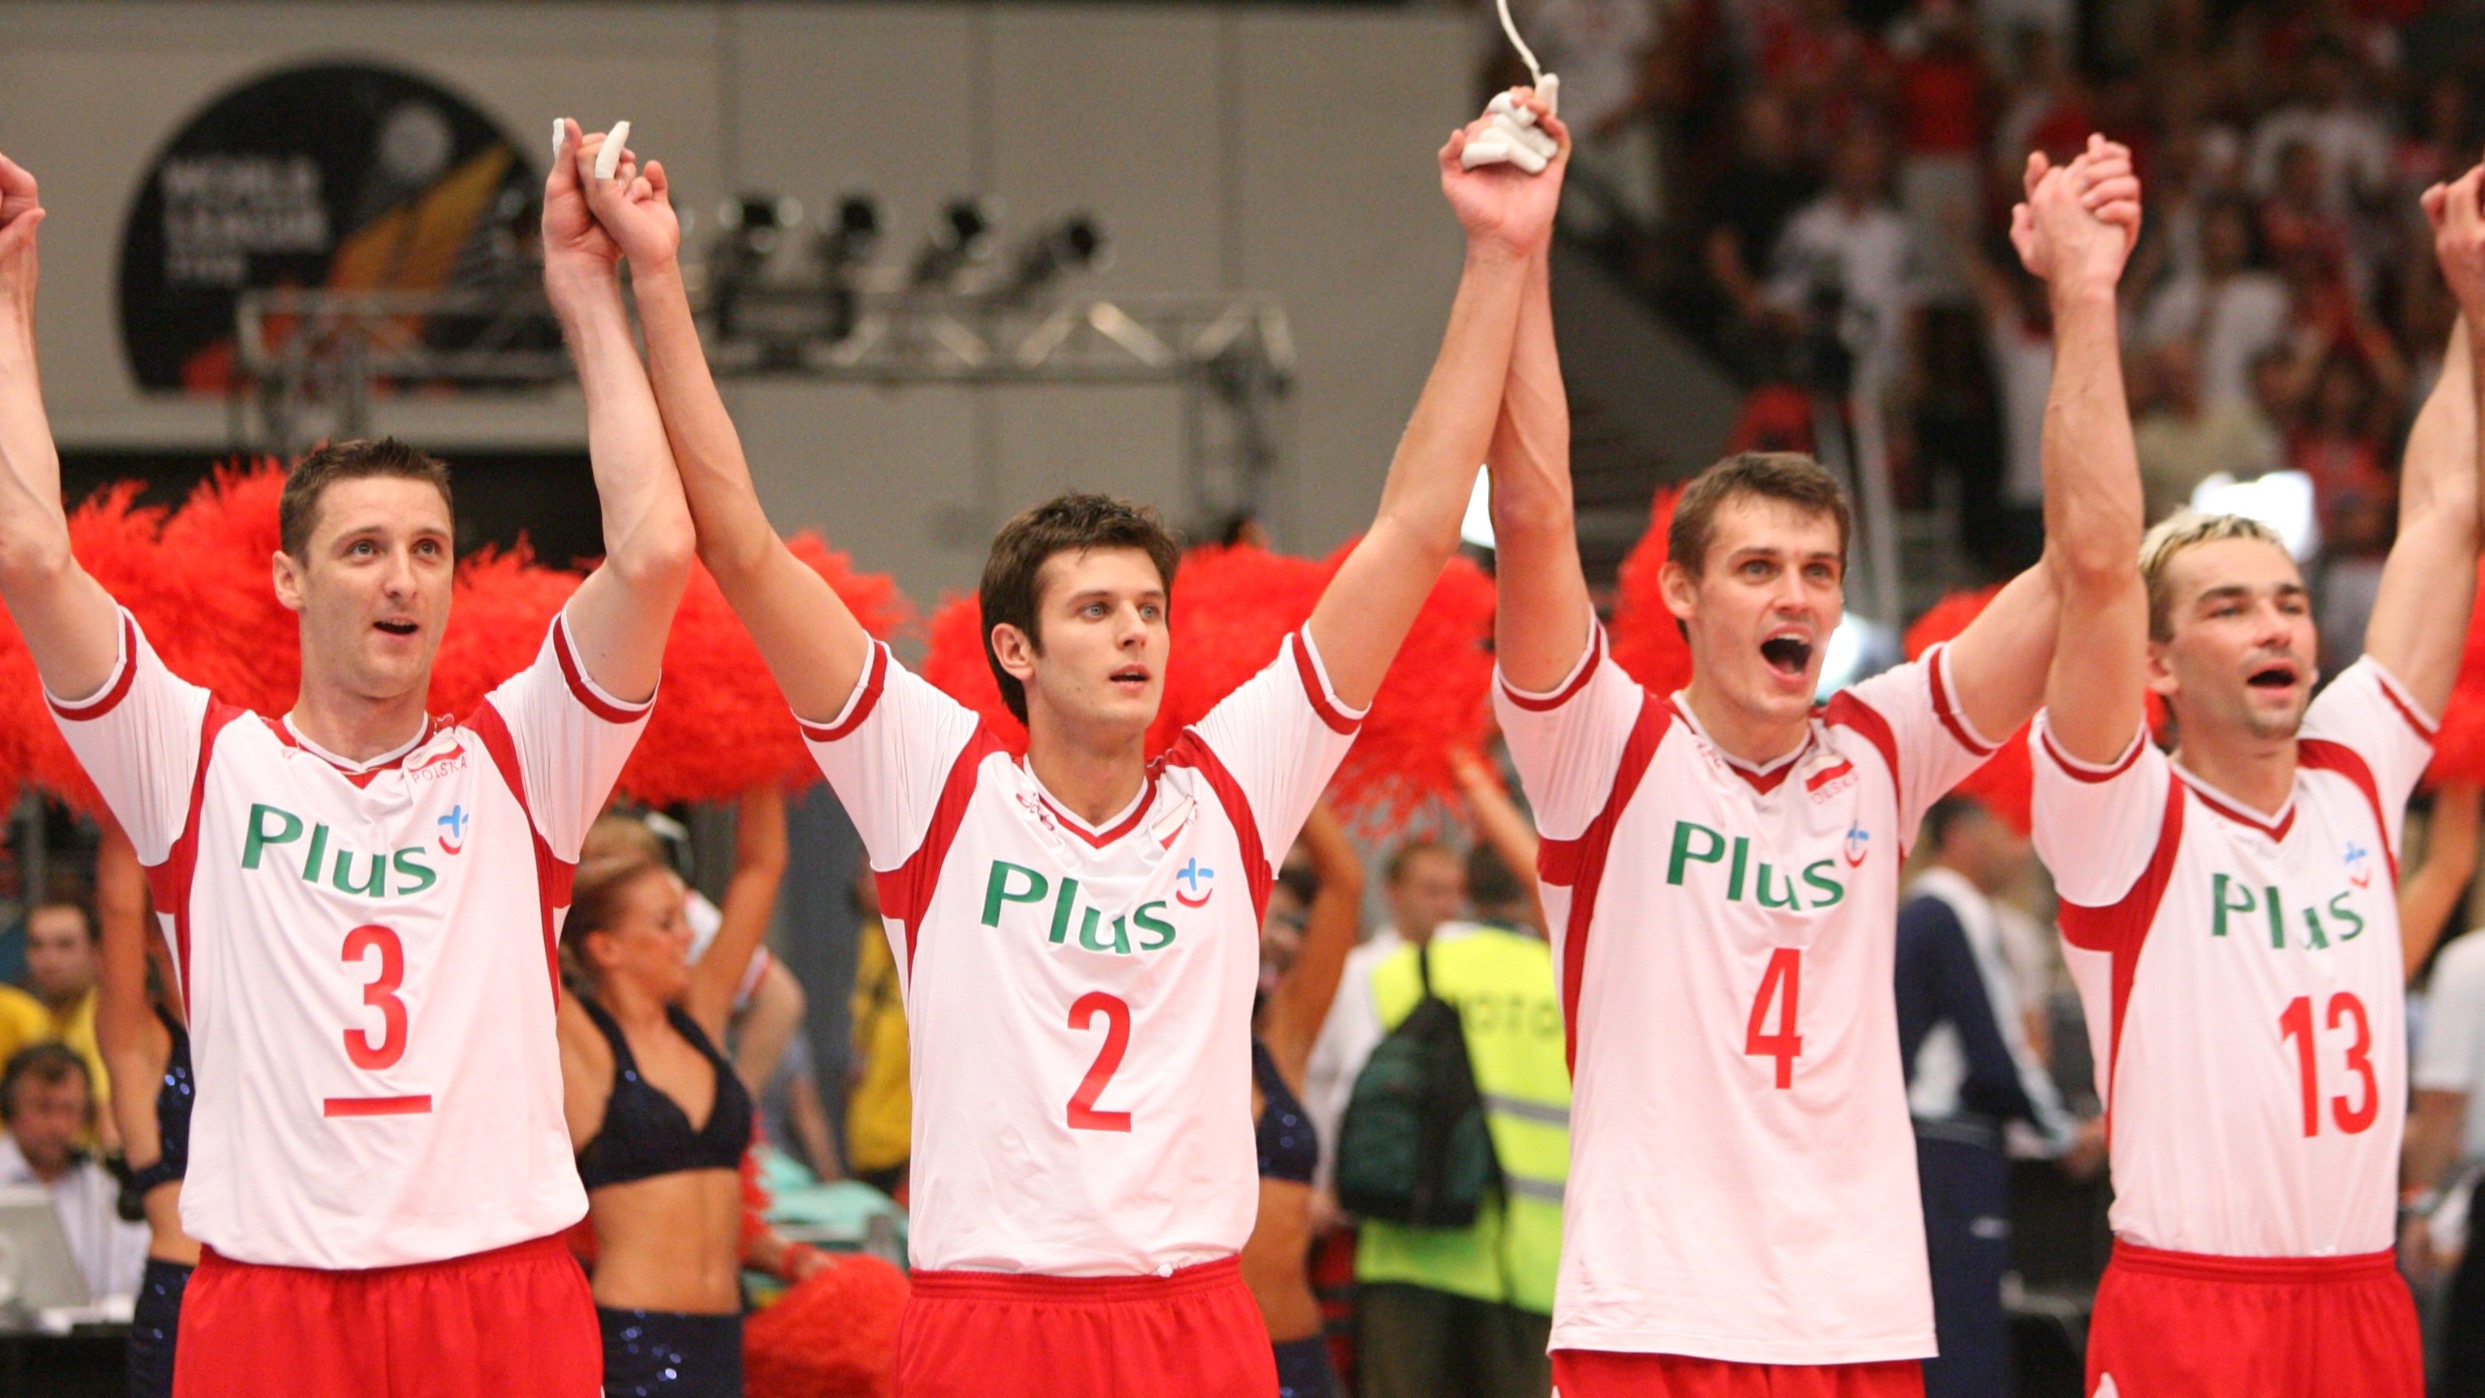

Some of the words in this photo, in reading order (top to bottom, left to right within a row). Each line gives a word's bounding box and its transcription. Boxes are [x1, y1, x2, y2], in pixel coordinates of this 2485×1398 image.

[411, 755, 468, 785] POLSKA
[242, 803, 437, 898] Plus
[1667, 820, 1845, 911] Plus
[981, 859, 1177, 956] Plus
[2211, 872, 2366, 950] Plus
[340, 922, 410, 1072] 3
[1742, 945, 1805, 1091] 4
[1065, 989, 1133, 1134] 2
[2277, 990, 2381, 1139] 13
